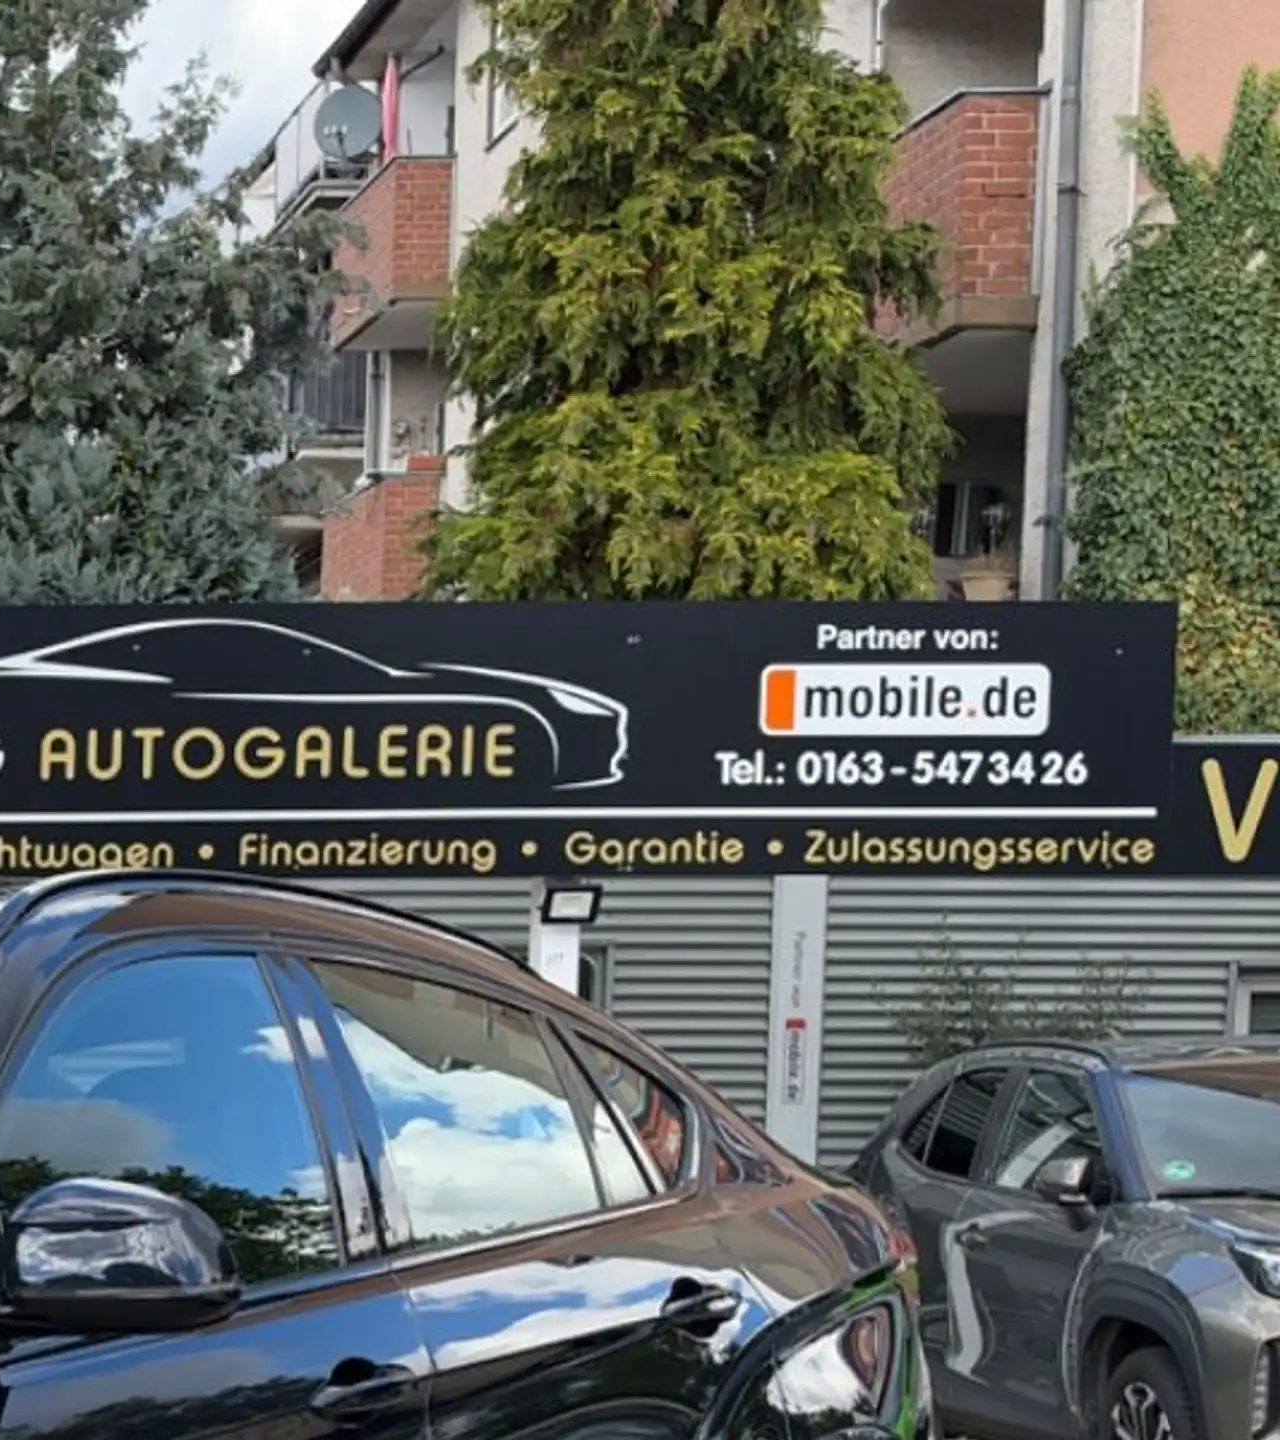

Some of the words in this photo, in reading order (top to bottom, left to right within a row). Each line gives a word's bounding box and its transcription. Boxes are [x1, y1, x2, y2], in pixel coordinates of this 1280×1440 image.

[816, 624, 926, 650] Partner
[932, 629, 999, 650] von:
[804, 675, 1037, 718] mobile.de
[40, 724, 516, 780] AUTOGALERIE
[715, 750, 786, 785] Tel.:
[1202, 757, 1279, 862] V
[239, 833, 496, 869] Finanzierung
[564, 831, 744, 864] Garantie
[803, 830, 1155, 871] Zulassungsservice
